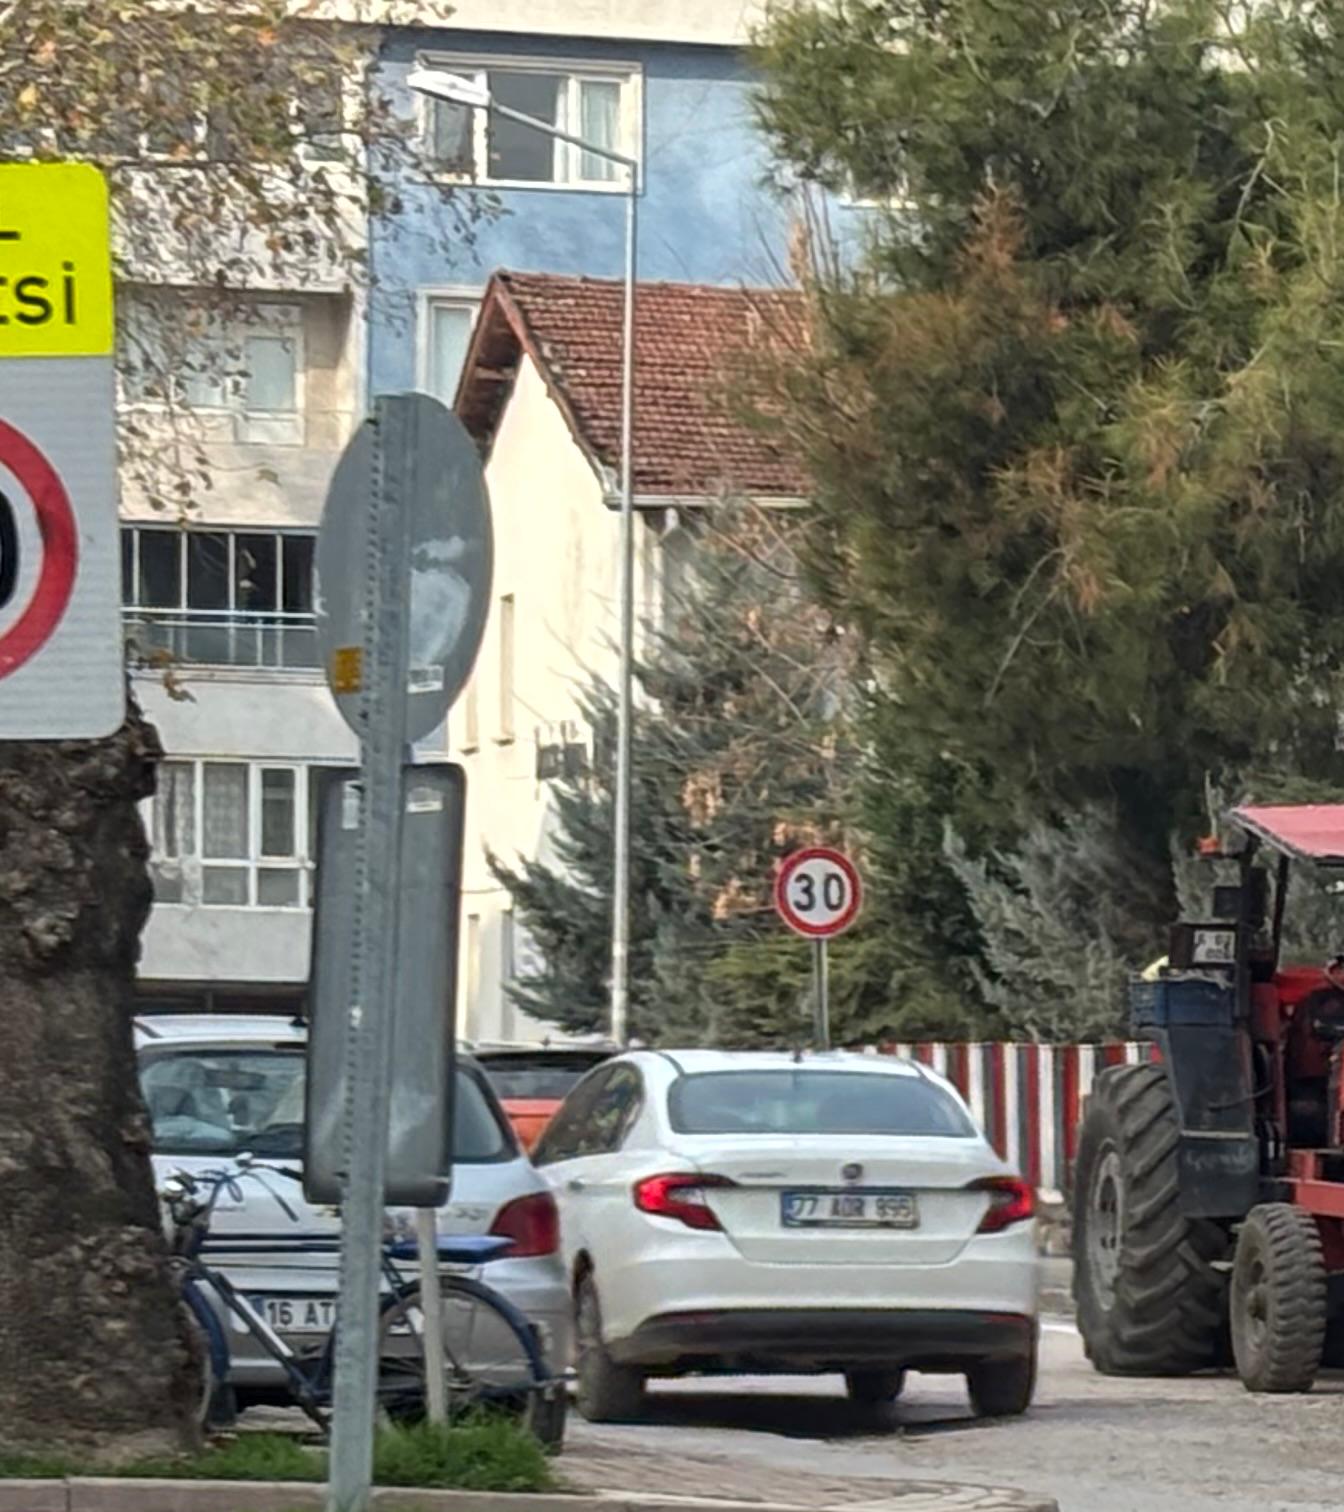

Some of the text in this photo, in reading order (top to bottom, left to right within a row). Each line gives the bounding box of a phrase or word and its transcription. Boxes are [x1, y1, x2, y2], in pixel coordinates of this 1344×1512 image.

[793, 872, 844, 912] 30
[793, 1197, 819, 1217] 77
[267, 1301, 293, 1326] 16
